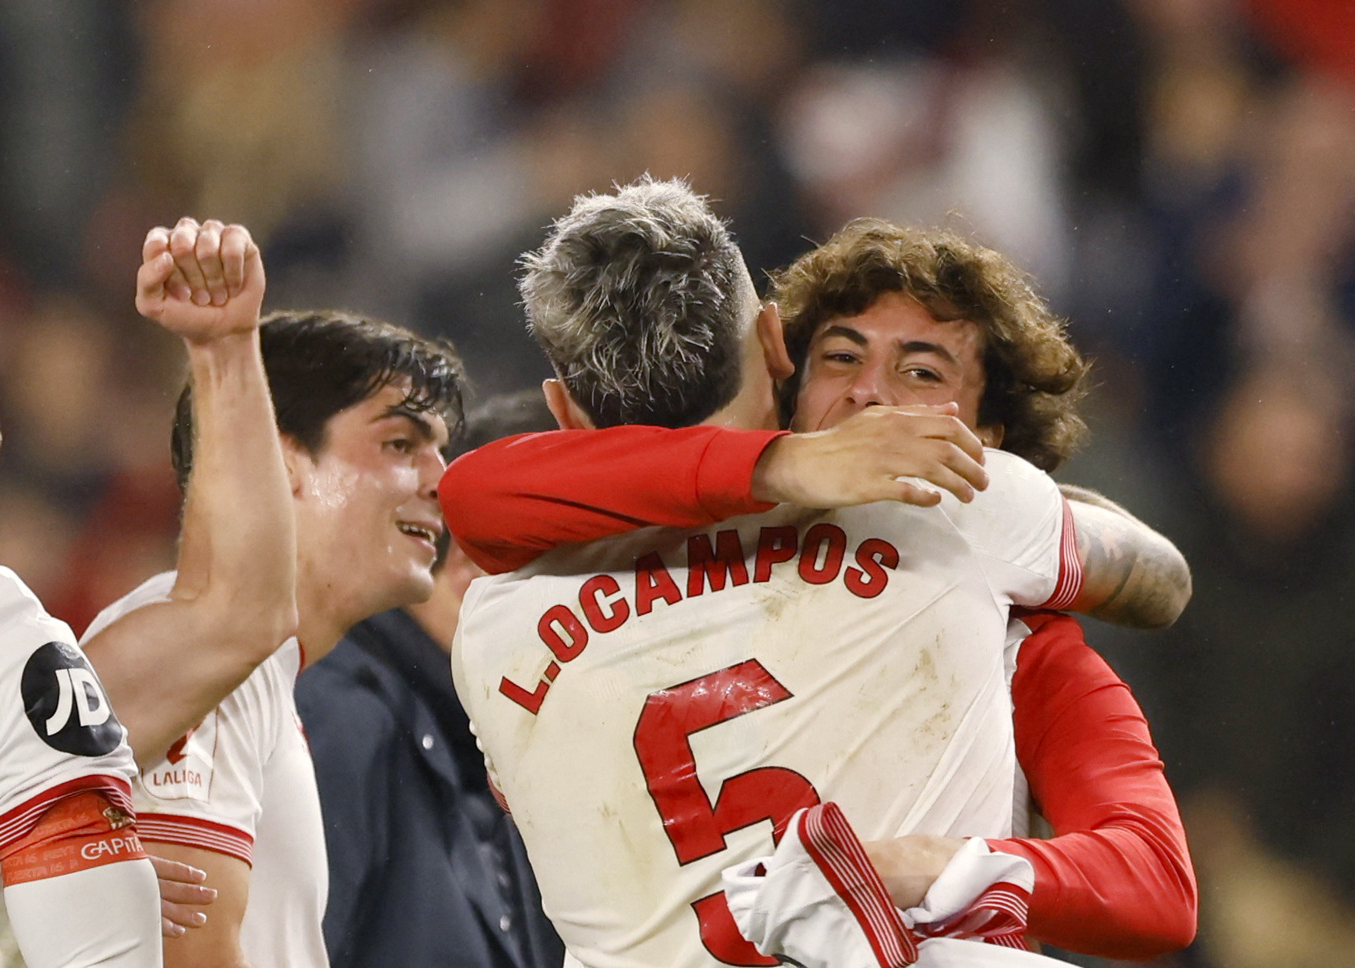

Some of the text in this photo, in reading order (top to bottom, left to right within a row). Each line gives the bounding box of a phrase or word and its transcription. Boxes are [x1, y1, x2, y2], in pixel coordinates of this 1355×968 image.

[498, 522, 900, 716] L.OCAMPOS
[45, 667, 111, 736] JD
[152, 769, 203, 788] LALIGA
[632, 657, 822, 968] 5
